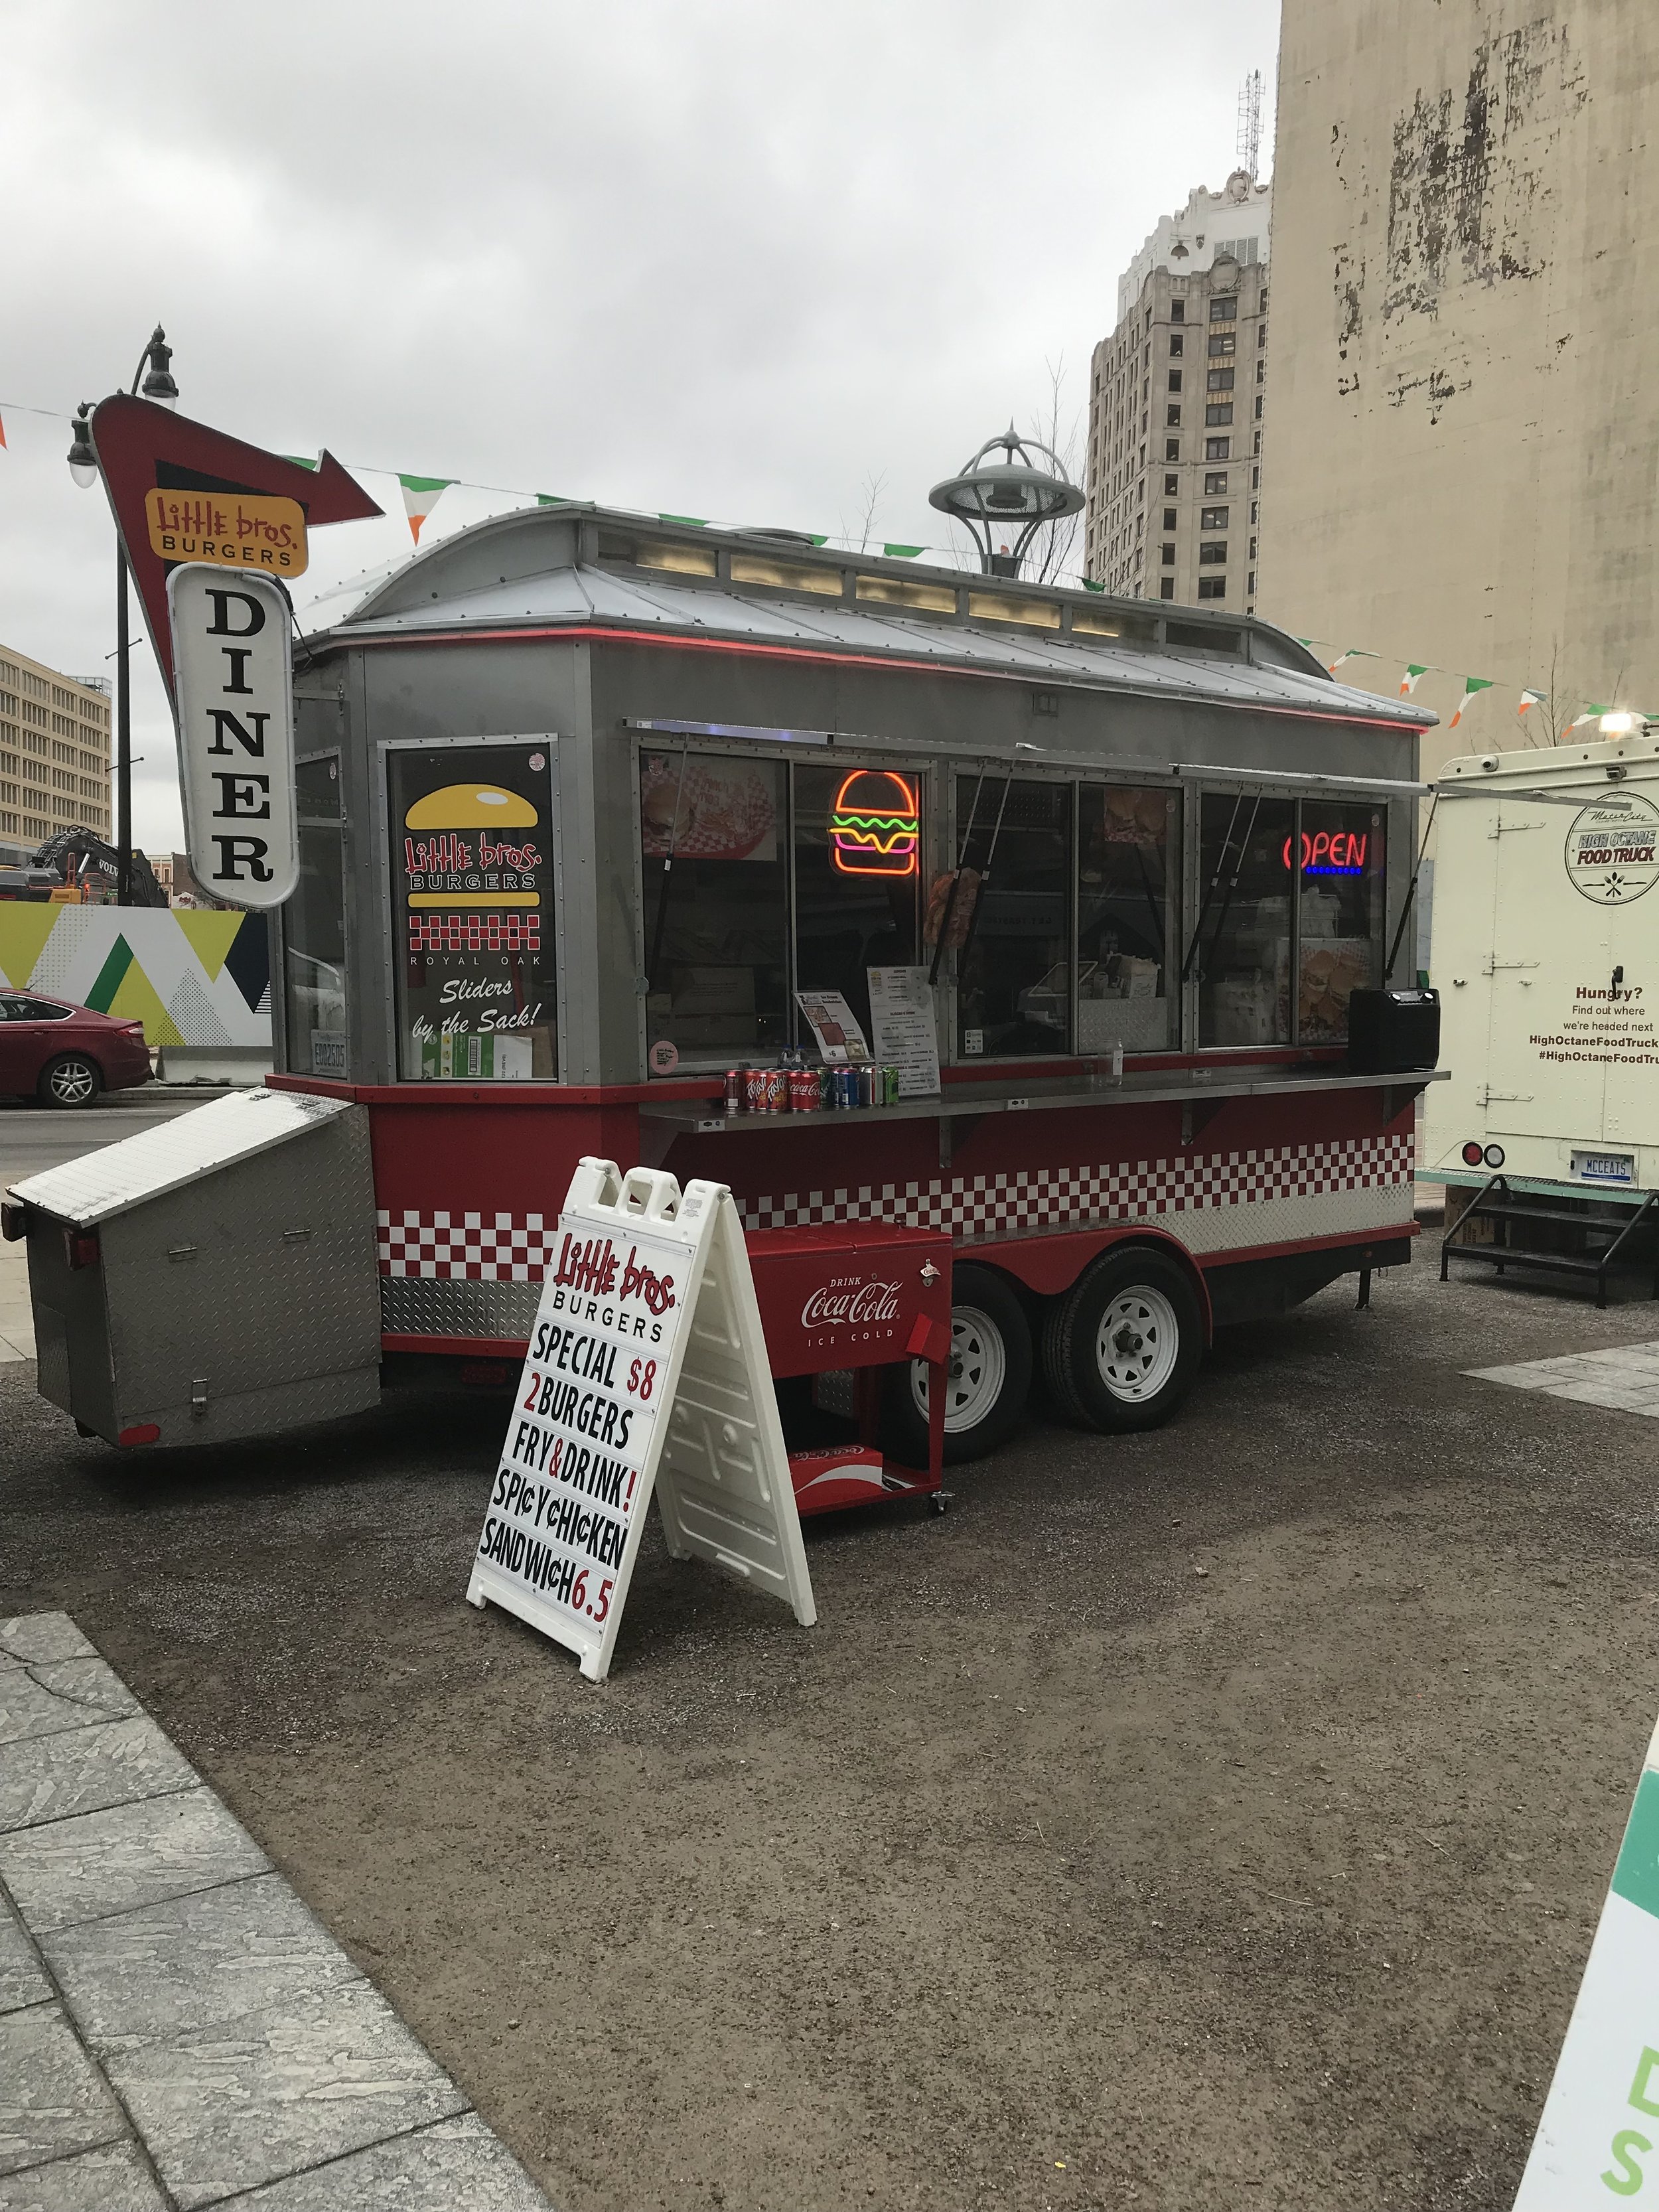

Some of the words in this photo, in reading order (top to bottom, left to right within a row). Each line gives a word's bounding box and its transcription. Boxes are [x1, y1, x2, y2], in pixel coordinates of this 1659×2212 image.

[162, 535, 291, 566] BURGERS
[206, 588, 273, 883] DINER
[1578, 833, 1609, 849] HIGH
[1610, 830, 1656, 847] OCTANE
[1282, 831, 1368, 871] OPEN
[1577, 849, 1613, 865] FOOD
[1613, 847, 1656, 863] TRUCK
[99, 859, 119, 877] VOLV
[410, 873, 535, 890] BURGERS
[501, 956, 540, 965] OAK
[439, 977, 514, 1003] Sliders
[1572, 1005, 1593, 1015] Find
[1614, 1006, 1645, 1015] where
[412, 1015, 434, 1043] by
[441, 1011, 469, 1035] the
[476, 1003, 542, 1033] Sack!
[1563, 1021, 1589, 1030] we're
[1592, 1021, 1628, 1031] headed
[1631, 1023, 1653, 1031] next
[1587, 1159, 1626, 1175] MCCEATS
[830, 1277, 862, 1288] DRINK
[801, 1281, 903, 1328] Coca-Cola
[552, 1290, 663, 1343] BURGERS
[808, 1337, 835, 1347] ICE
[851, 1329, 893, 1341] COLD
[532, 1323, 617, 1389] SPECIAL
[627, 1357, 657, 1400] $8
